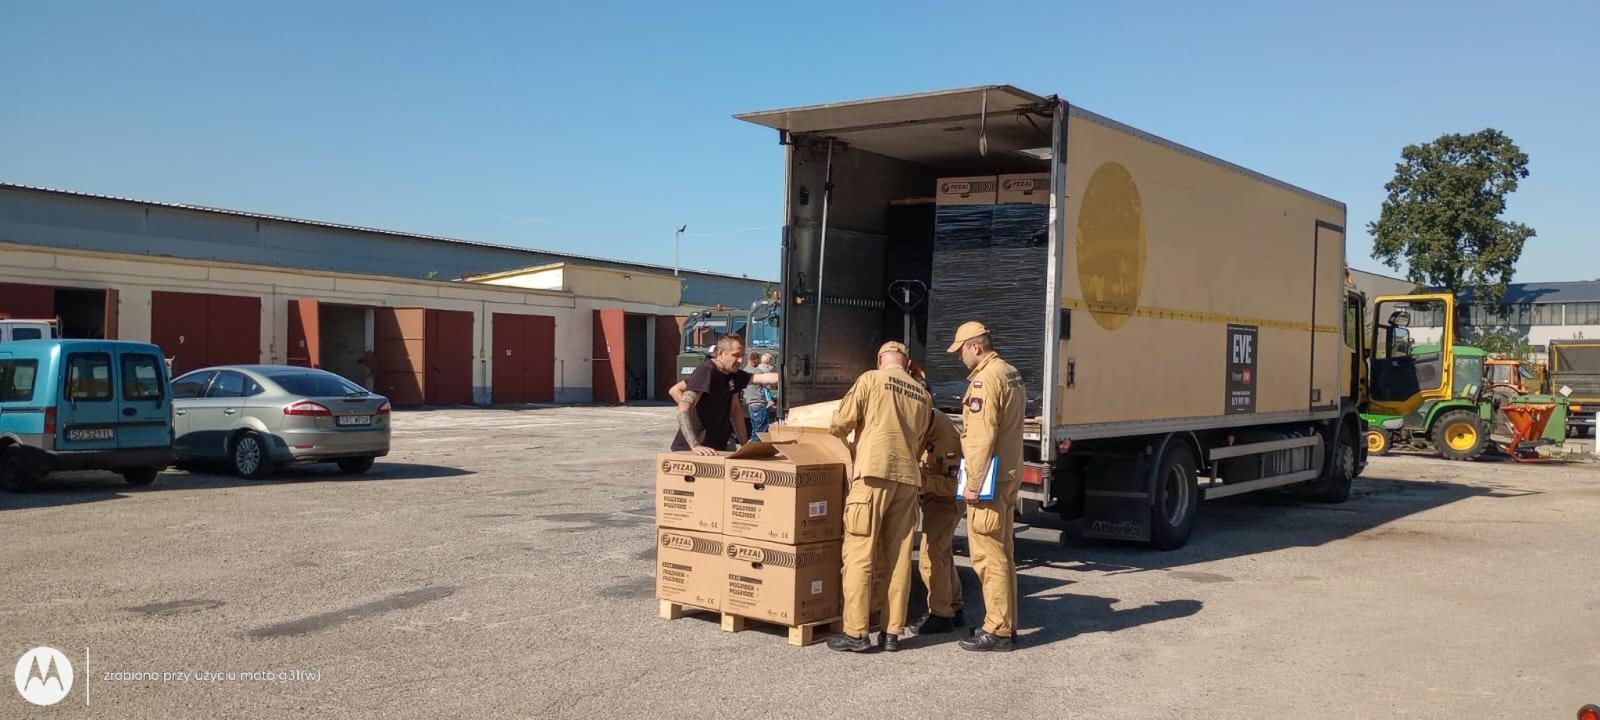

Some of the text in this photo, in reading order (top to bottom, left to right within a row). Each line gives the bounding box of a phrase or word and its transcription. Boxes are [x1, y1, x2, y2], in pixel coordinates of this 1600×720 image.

[179, 335, 185, 344] 9
[1232, 334, 1252, 364] EVE
[672, 463, 693, 471] PEZAL
[741, 470, 763, 479] PEZAL
[671, 536, 691, 546] PEZAL
[739, 548, 761, 558] PEZAL
